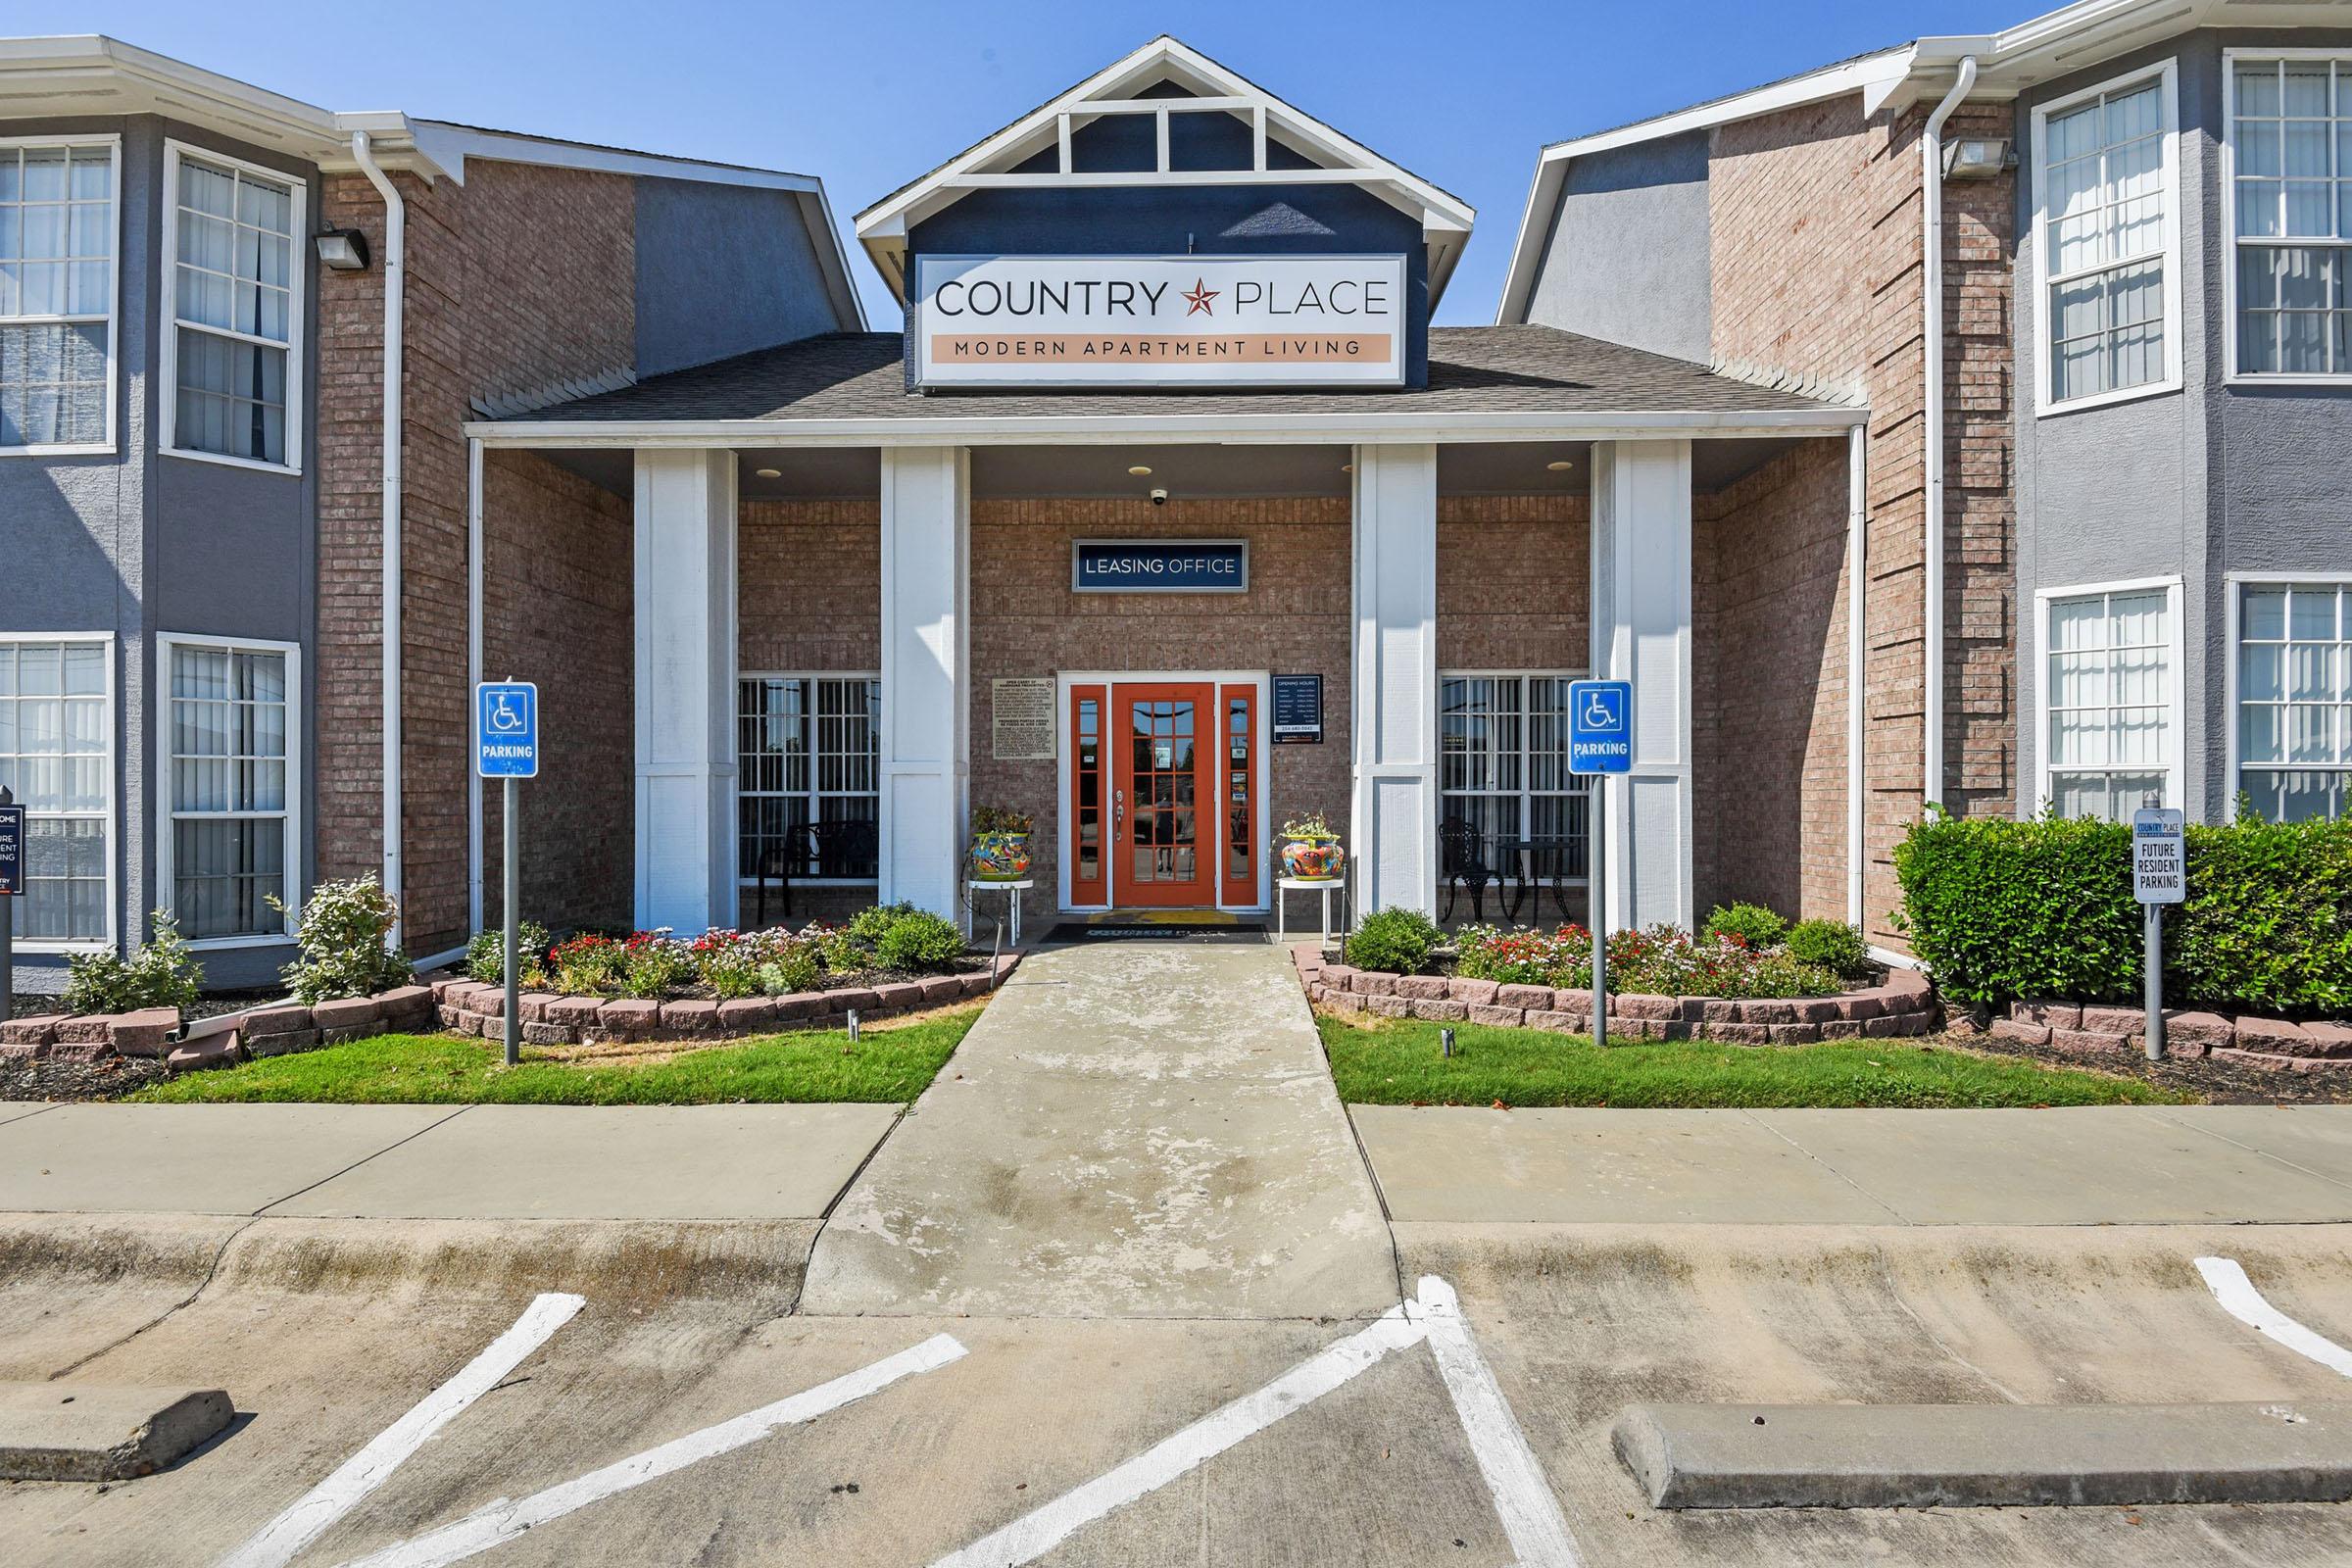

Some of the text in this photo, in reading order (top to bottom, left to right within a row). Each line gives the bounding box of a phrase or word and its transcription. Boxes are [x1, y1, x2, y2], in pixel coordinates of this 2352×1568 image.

[935, 279, 1389, 317] COUNTRY PLACE
[955, 339, 1360, 356] MODERN APARTMENT LIVING
[1086, 559, 1235, 573] LEASING OFFICE
[482, 745, 533, 758] PARKING
[1574, 743, 1628, 756] PARKING
[2137, 823, 2180, 832] COUNTRY PLACE
[2142, 844, 2175, 857] FUTURE
[2138, 859, 2180, 873] RESIDENT
[2140, 875, 2179, 889] PARKING
